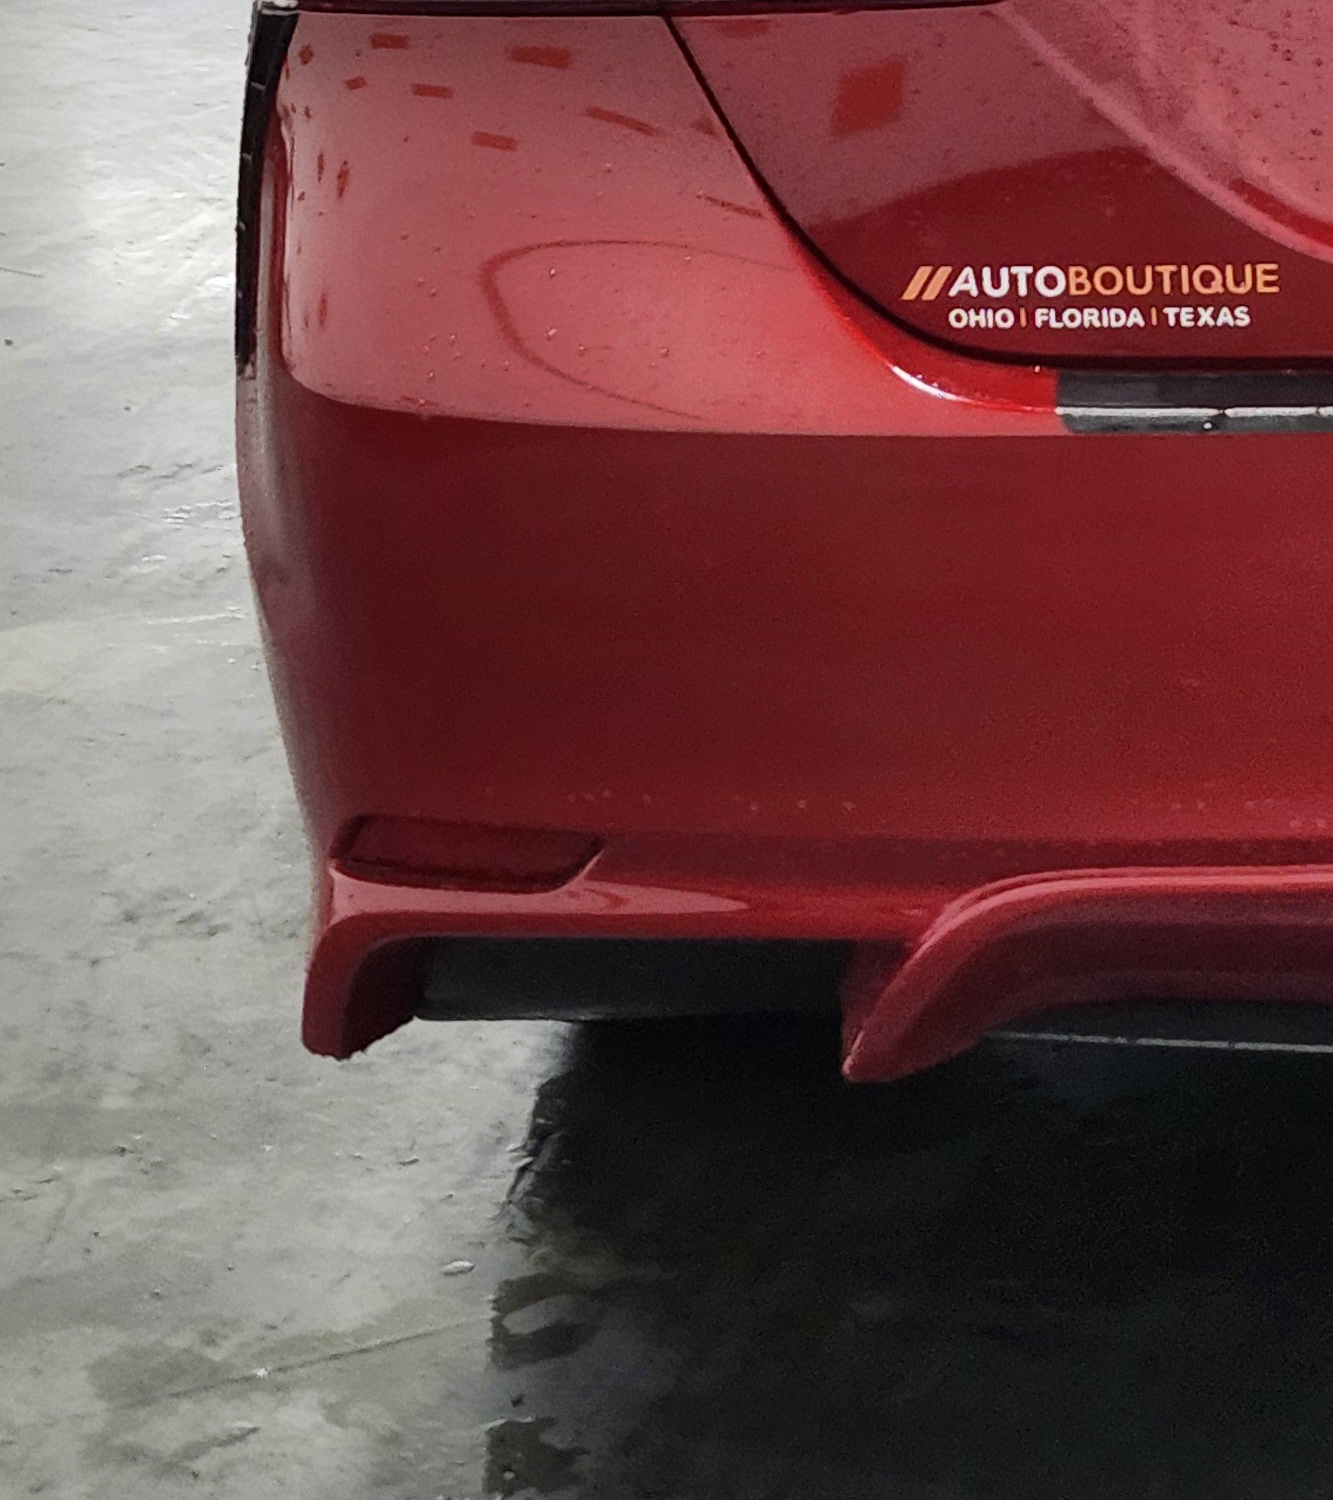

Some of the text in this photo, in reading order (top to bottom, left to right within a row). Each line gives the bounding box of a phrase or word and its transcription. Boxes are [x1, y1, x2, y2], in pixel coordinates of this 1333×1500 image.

[948, 305, 1251, 329] OHIO FLORIDA TEXAS
